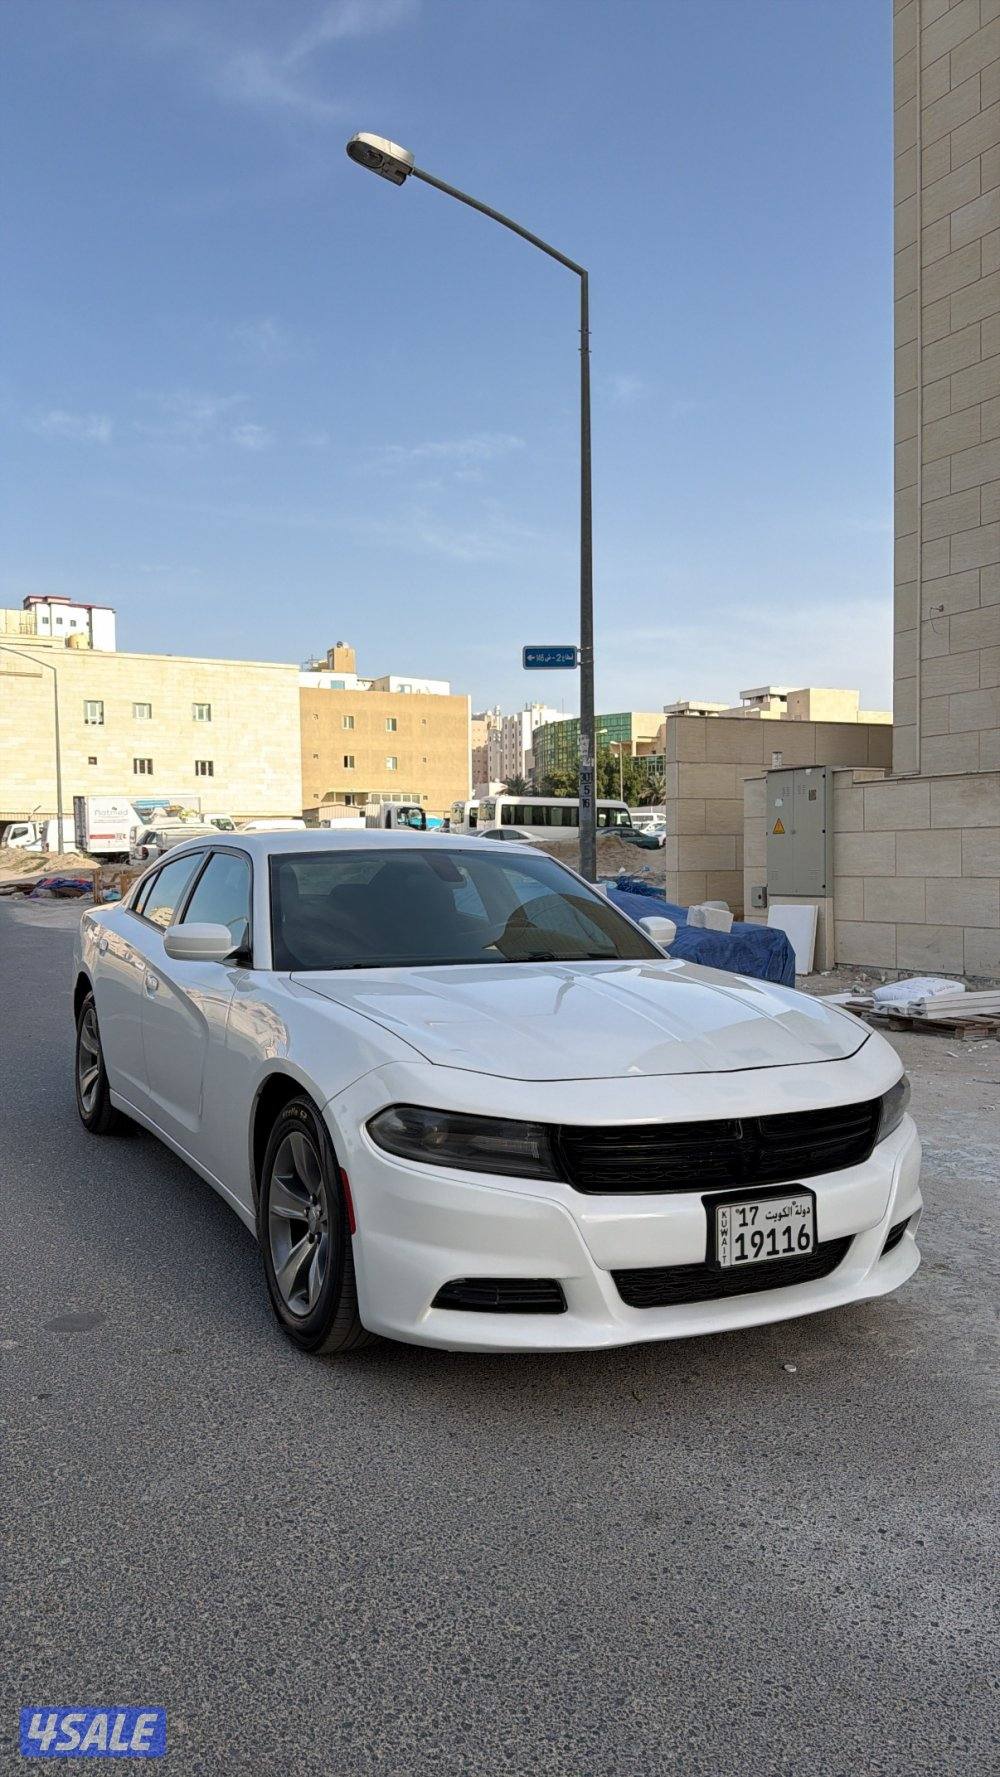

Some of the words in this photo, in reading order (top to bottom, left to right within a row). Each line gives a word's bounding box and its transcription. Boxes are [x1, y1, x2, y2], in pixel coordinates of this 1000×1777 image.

[555, 653, 561, 662] 2
[584, 785, 590, 795] 5
[582, 798, 590, 808] 16
[738, 1206, 759, 1227] 17
[765, 1205, 793, 1222] الكويت
[795, 1204, 811, 1218] دولة
[720, 1210, 729, 1264] KUWAIT
[735, 1223, 811, 1261] 19116
